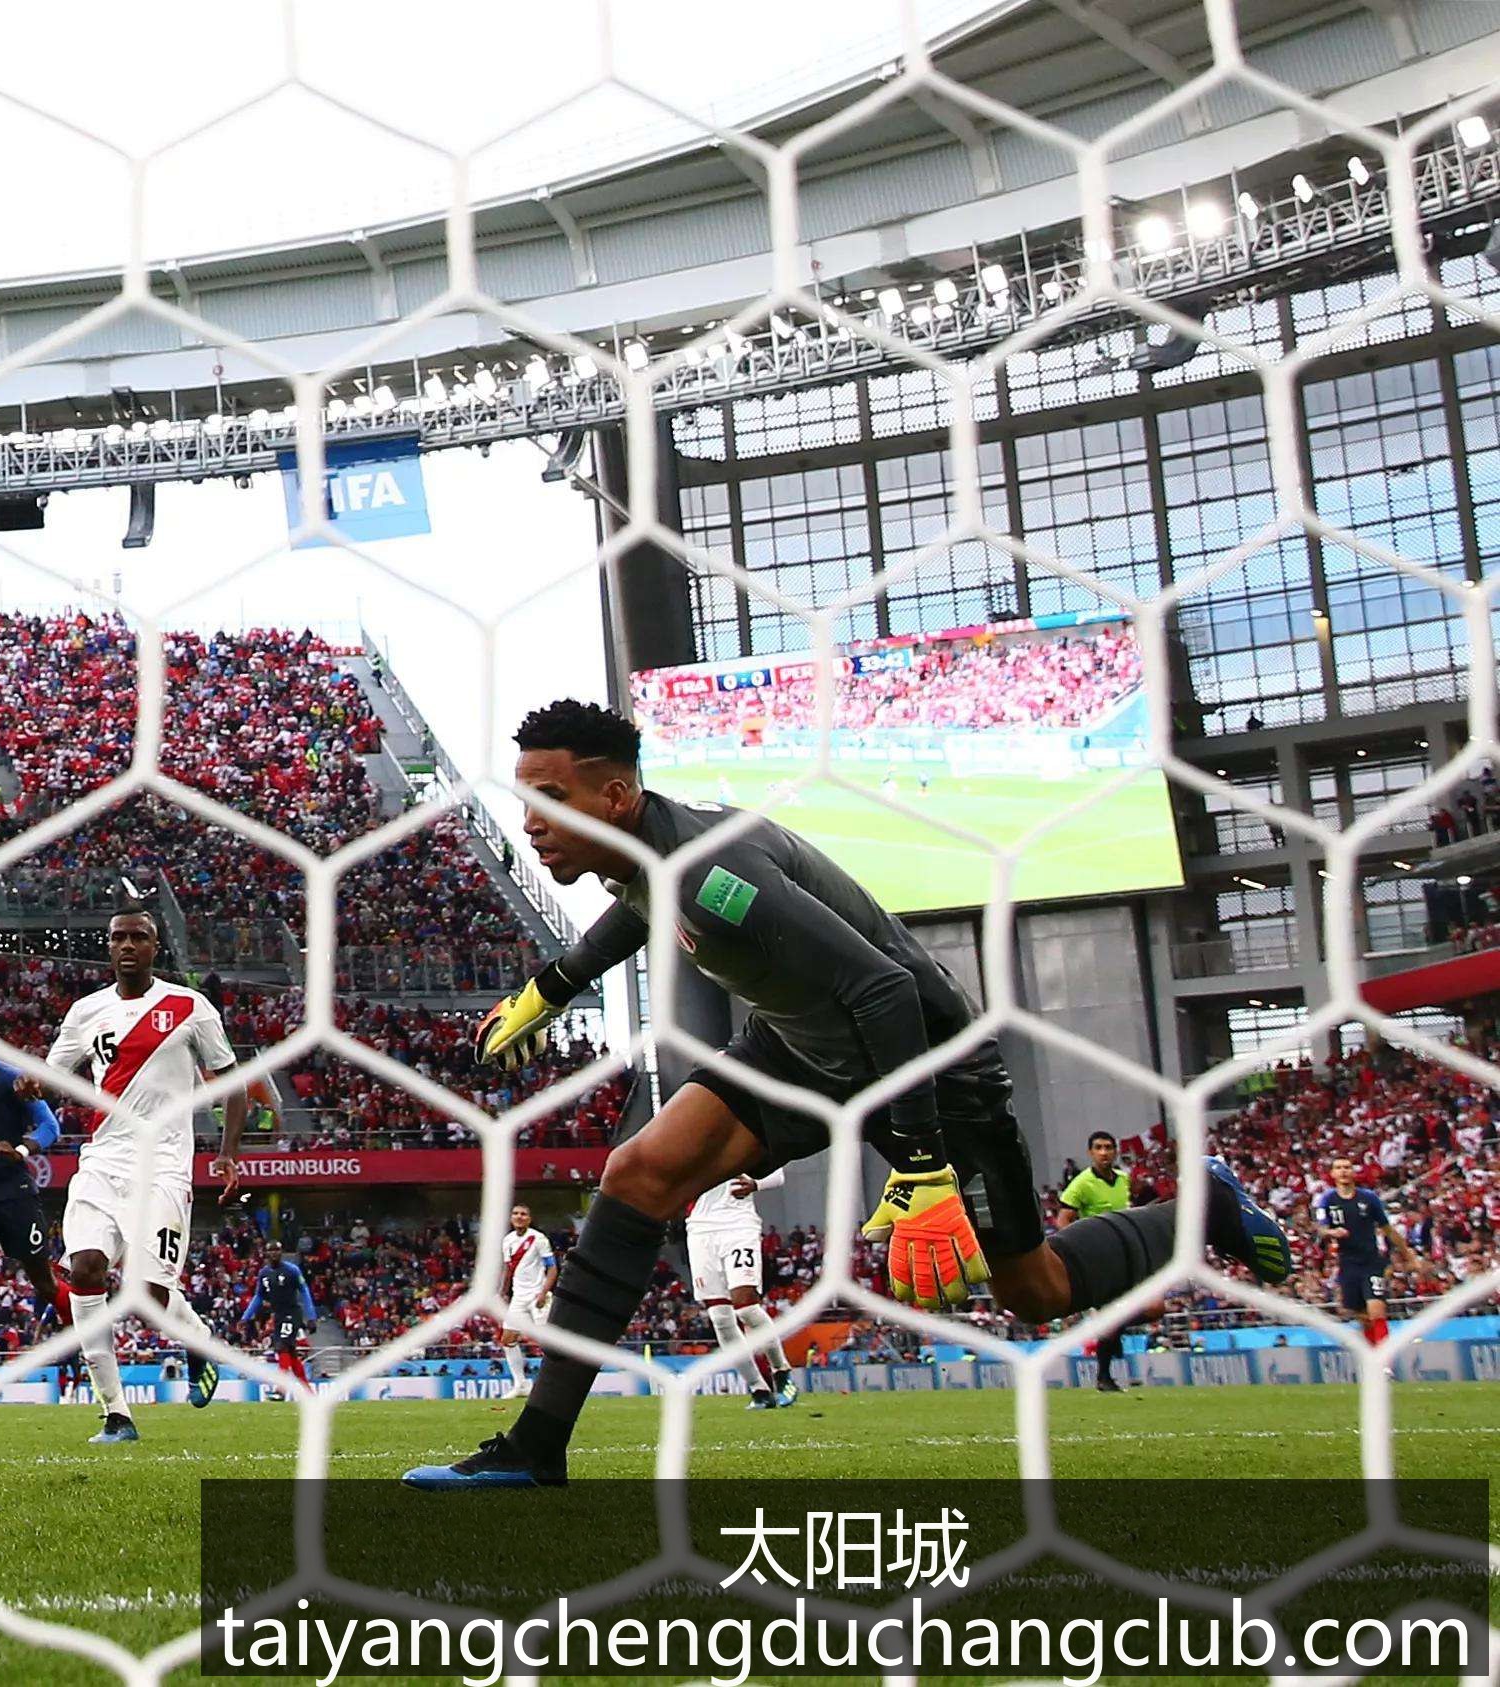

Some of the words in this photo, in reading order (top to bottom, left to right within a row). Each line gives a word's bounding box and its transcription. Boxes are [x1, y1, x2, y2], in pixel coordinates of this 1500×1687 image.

[308, 470, 406, 513] IFA
[673, 680, 708, 695] FRA
[93, 1031, 118, 1066] 15
[208, 1158, 361, 1177] EATERINBURG
[29, 1223, 43, 1246] 6
[157, 1227, 181, 1264] 15
[731, 1248, 755, 1268] 23
